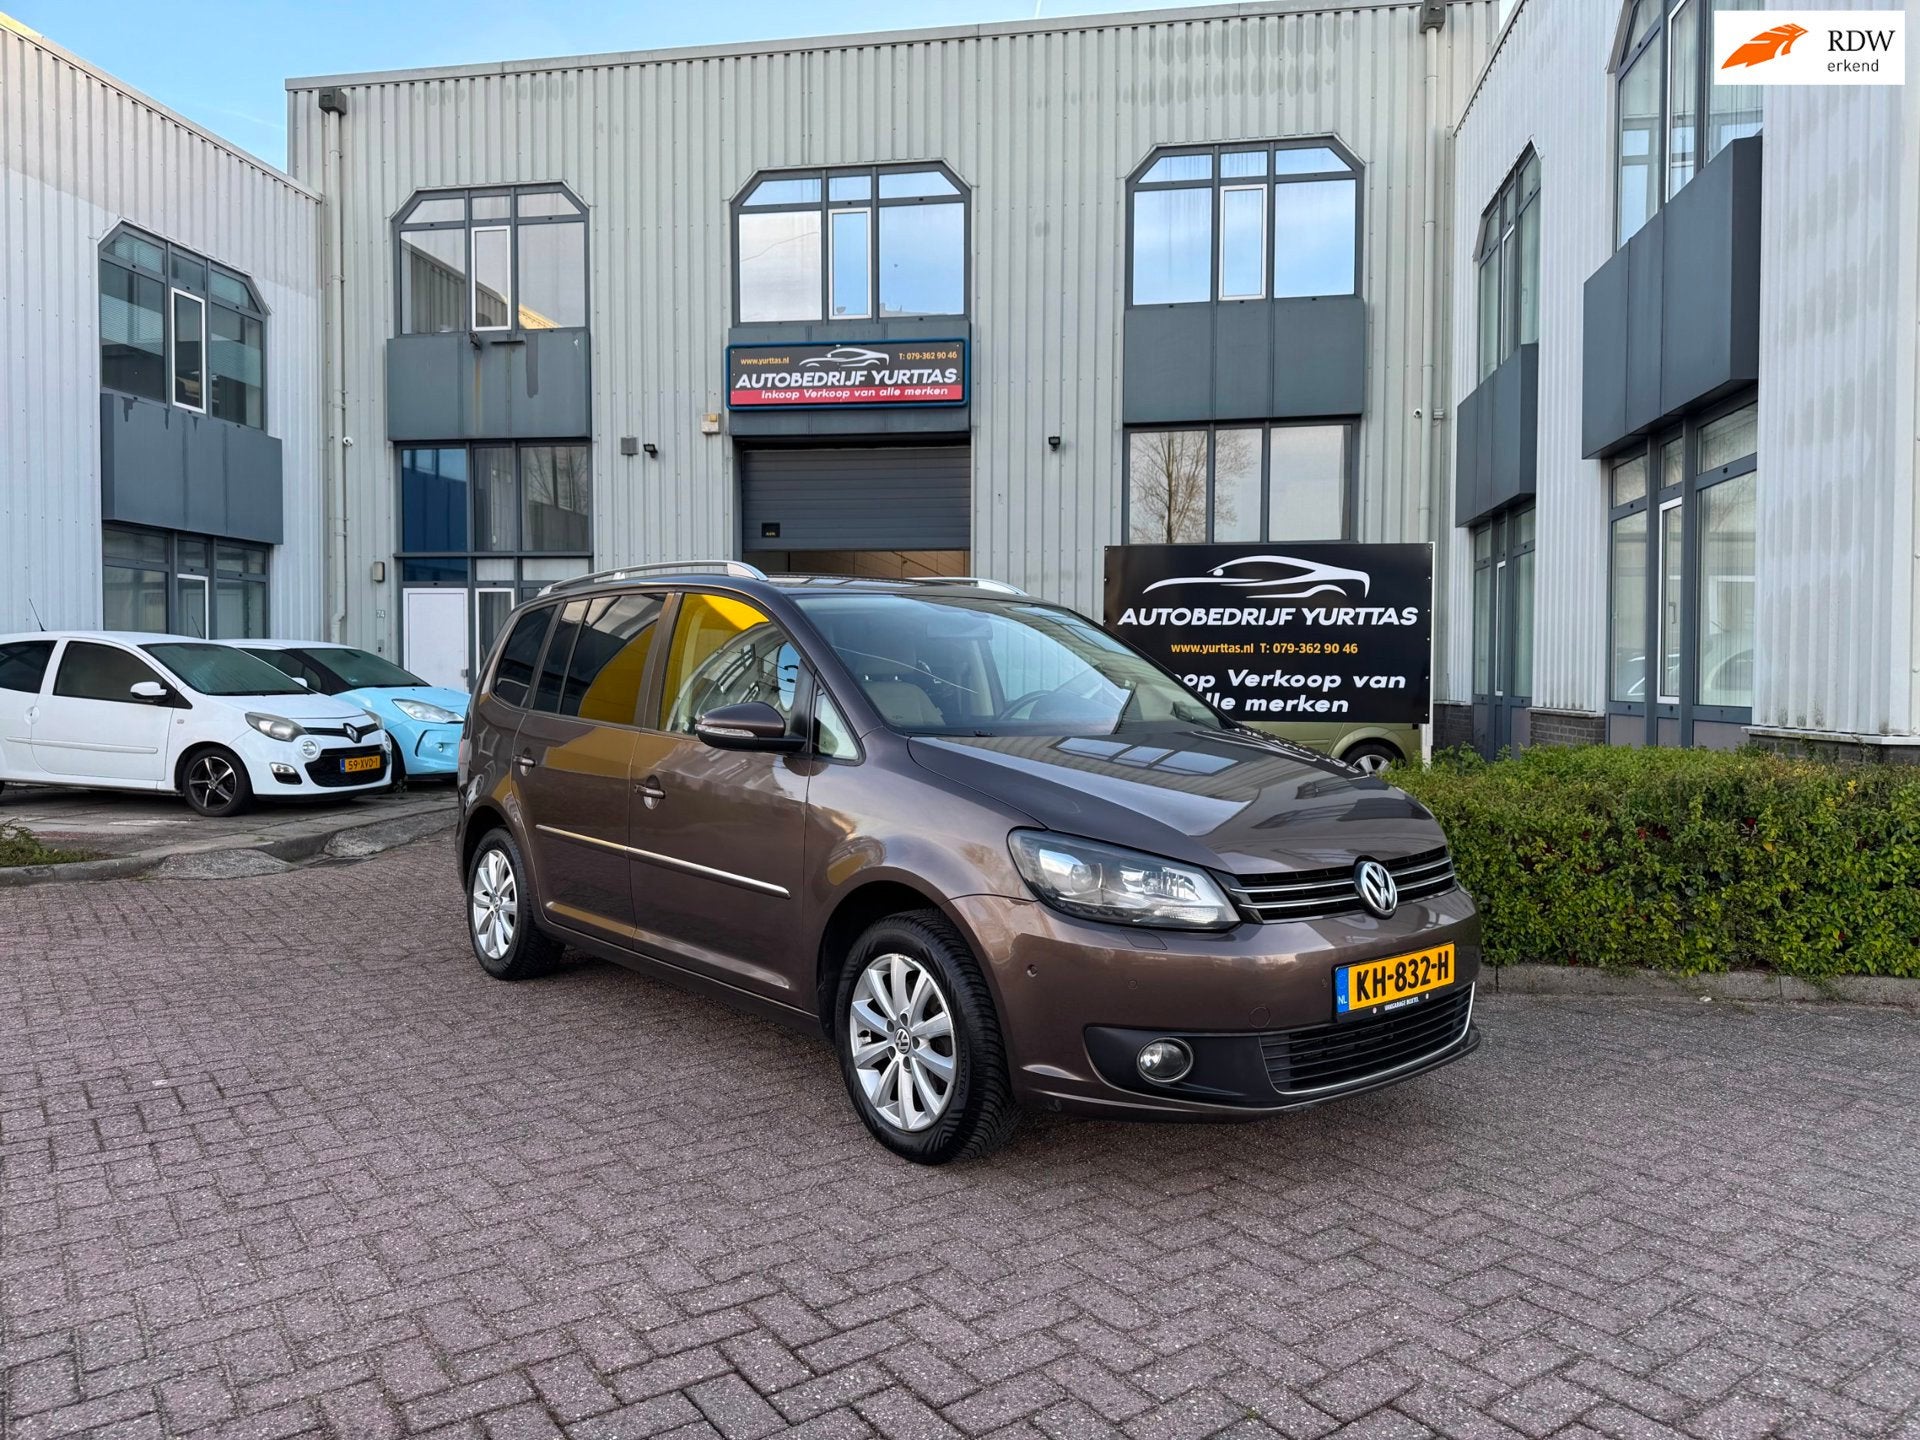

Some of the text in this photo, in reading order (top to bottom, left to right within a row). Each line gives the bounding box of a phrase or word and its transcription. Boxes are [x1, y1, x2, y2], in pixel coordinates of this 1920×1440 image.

[741, 356, 790, 366] www.yurttas.nl
[906, 352, 935, 360] 079-362
[947, 351, 957, 359] 46
[735, 368, 957, 388] AUTOBEDRIJF YURTTAS
[761, 386, 948, 400] Inkoop Verkoop van alle merken
[1117, 607, 1419, 626] AUTOBEDRIJF YURTTAS
[1171, 642, 1358, 655] www.yurttas.nl T: 079-362 90 46
[1227, 669, 1342, 693] Verkoop
[1353, 674, 1406, 689] van
[1205, 692, 1349, 713] lle merken
[1356, 950, 1449, 1002] KH-832-H
[1337, 995, 1348, 1005] NL
